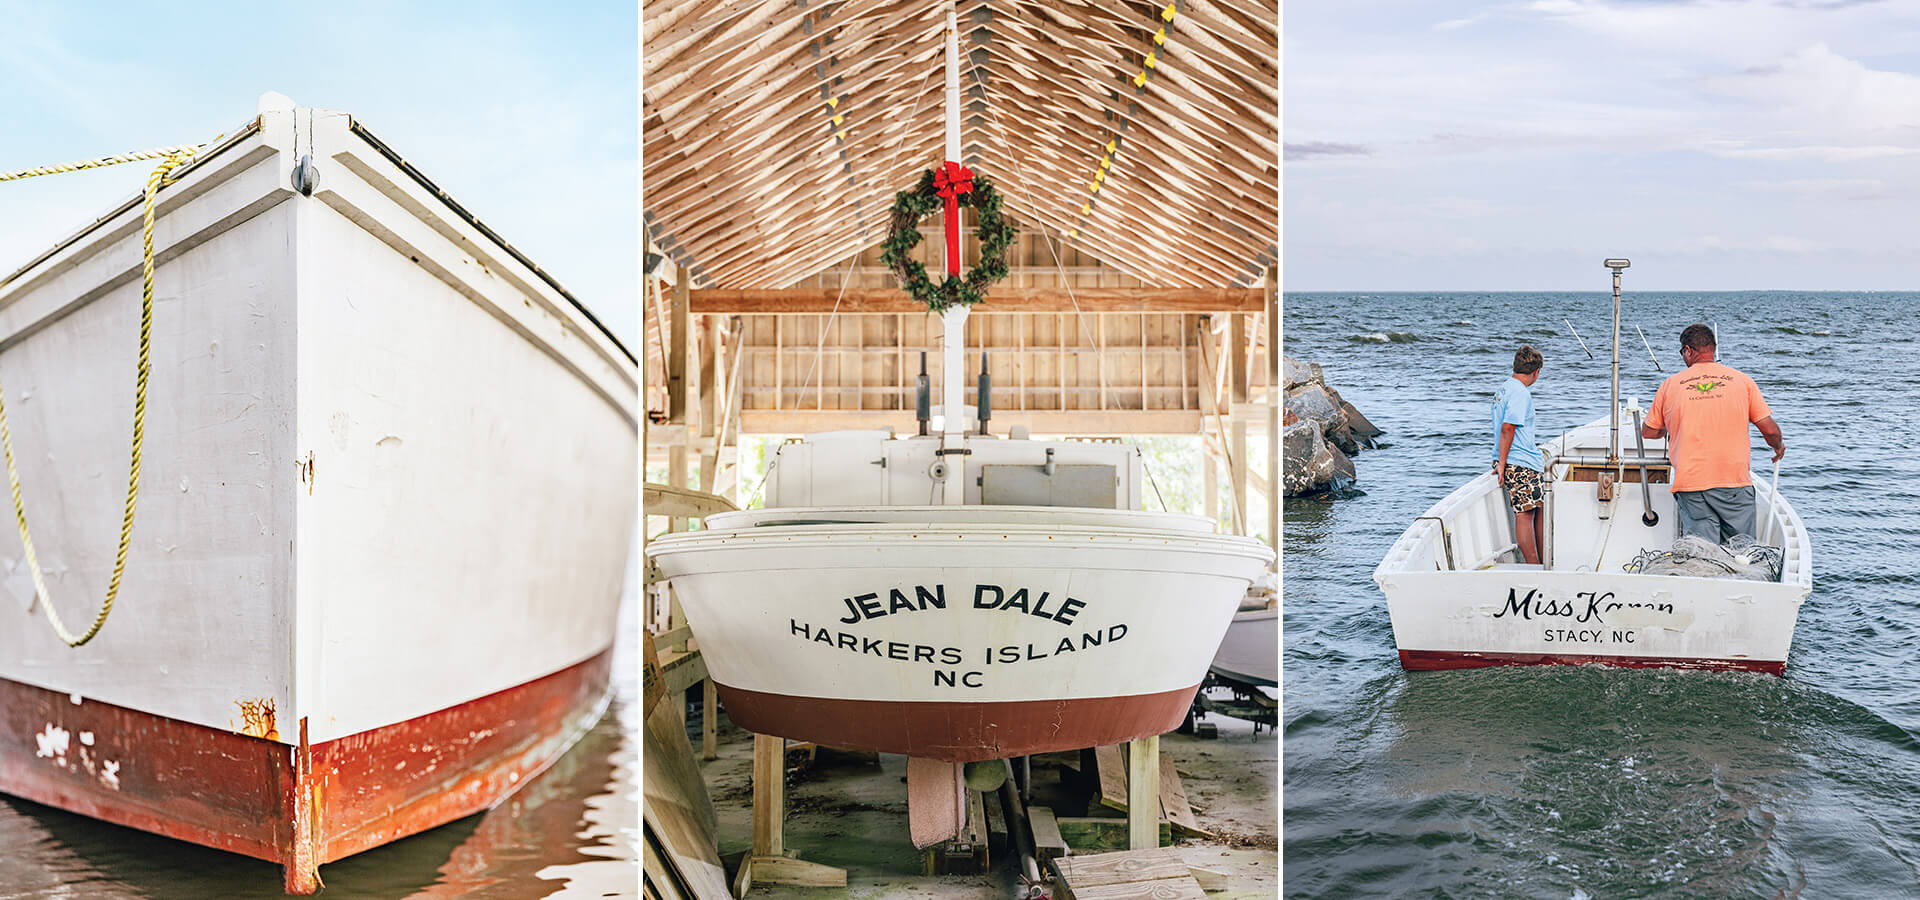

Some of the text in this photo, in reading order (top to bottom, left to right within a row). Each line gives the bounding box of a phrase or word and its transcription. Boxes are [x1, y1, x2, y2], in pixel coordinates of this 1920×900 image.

[839, 584, 1088, 626] JEAN DALE
[1493, 587, 1574, 620] Miss
[790, 618, 1129, 665] HARKERS ISLAND
[1612, 630, 1636, 644] NC
[934, 669, 984, 688] NC
